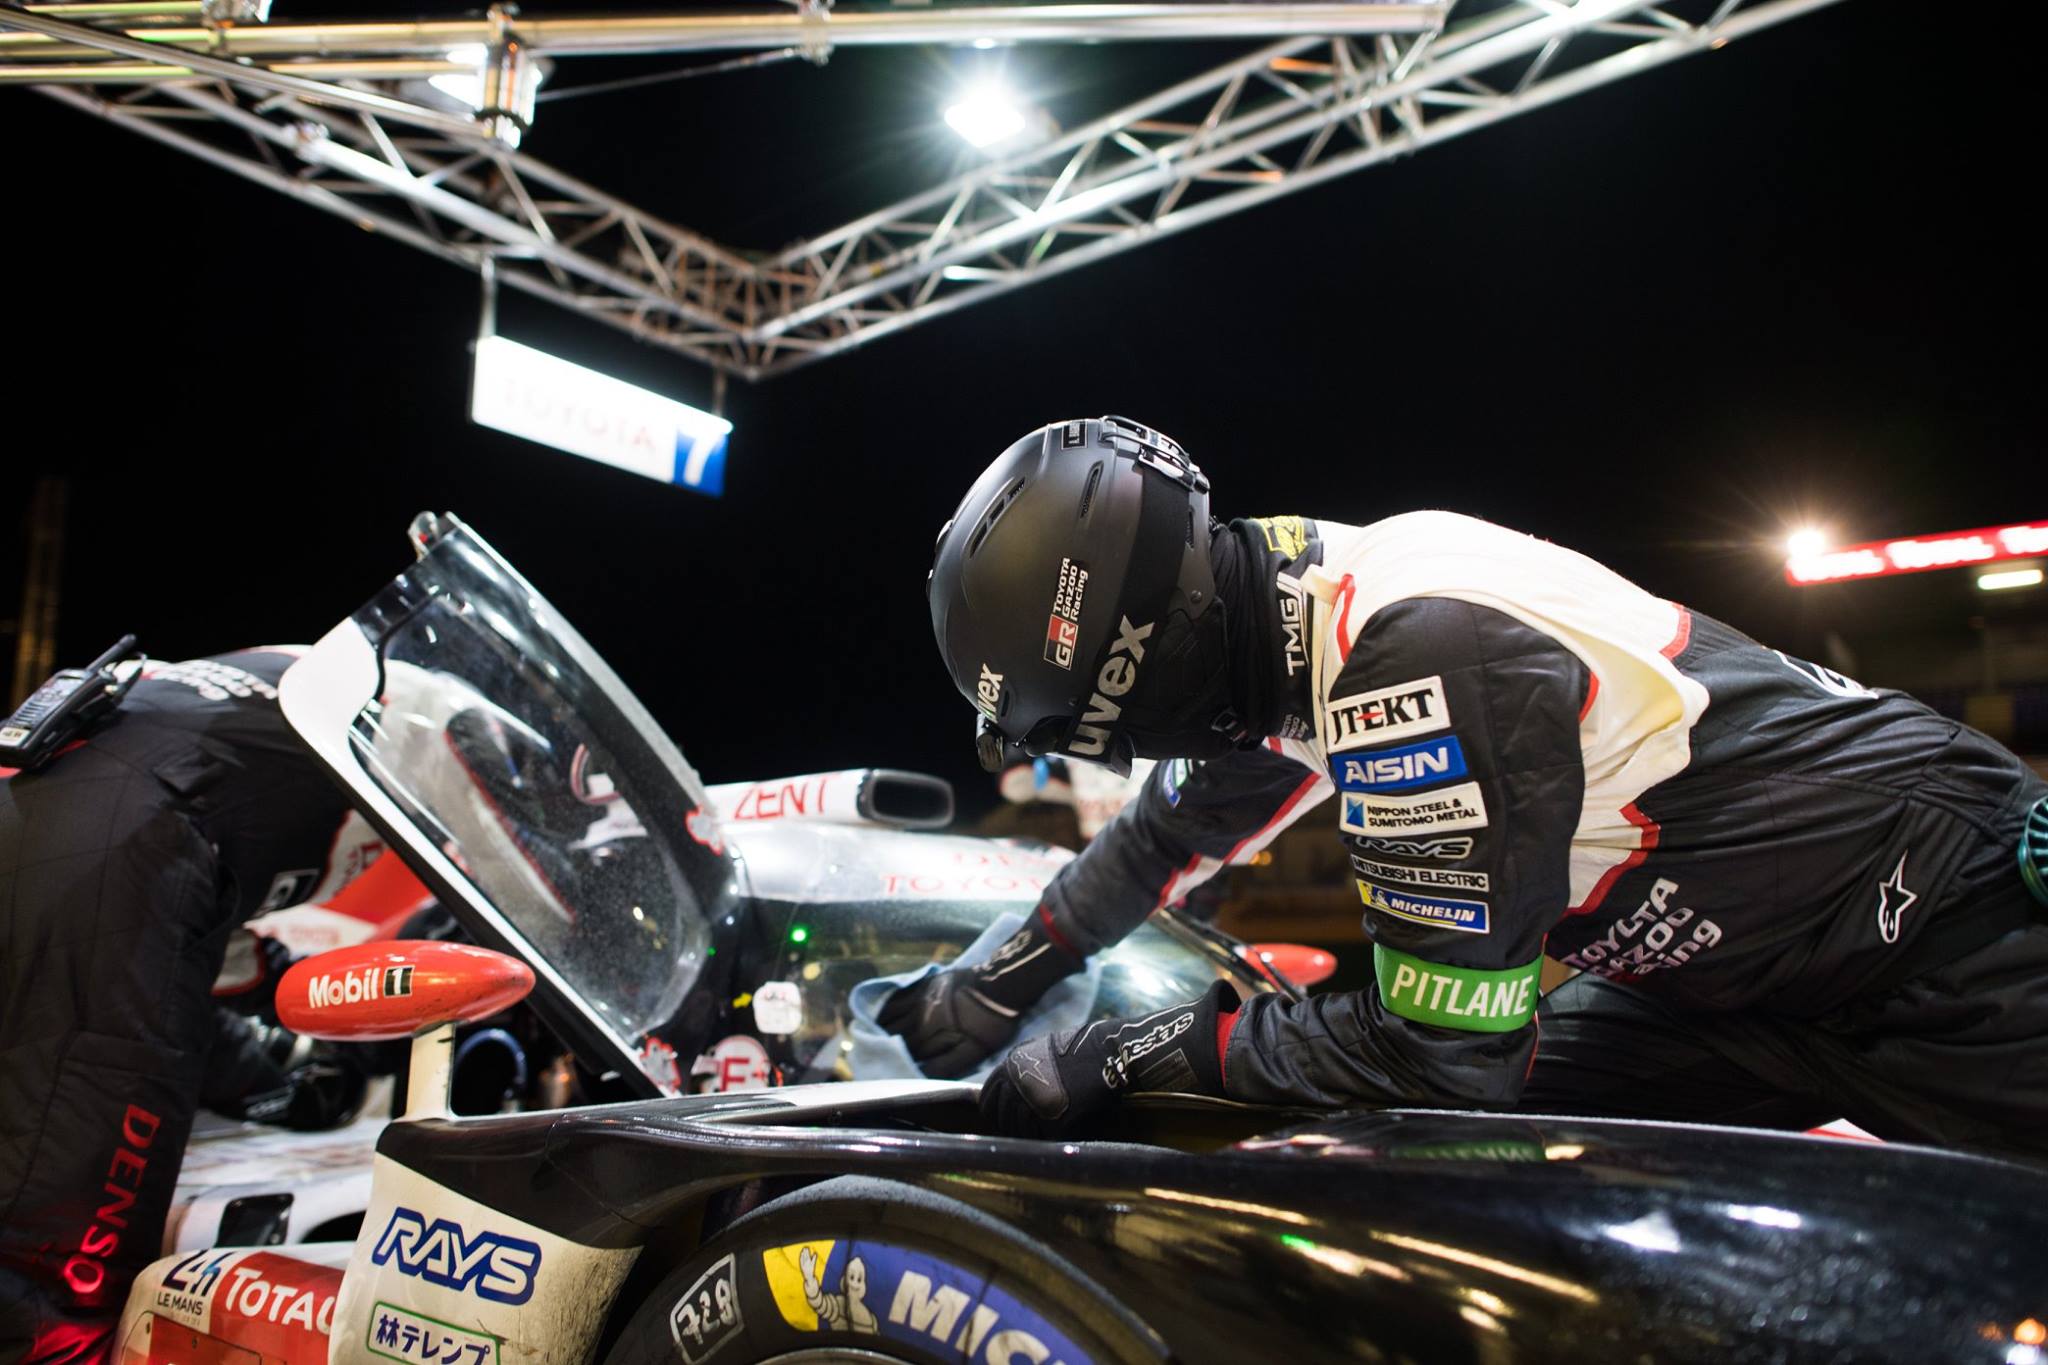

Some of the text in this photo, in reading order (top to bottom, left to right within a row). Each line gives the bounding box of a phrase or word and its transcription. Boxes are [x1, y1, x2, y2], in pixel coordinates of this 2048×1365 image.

[680, 426, 727, 487] 7
[1053, 557, 1071, 614] TOYOTA
[1062, 565, 1079, 618] GAZOO
[1070, 570, 1088, 622] Racing
[1055, 622, 1075, 667] GR
[1281, 598, 1306, 676] TMG
[1068, 614, 1154, 756] uvex
[1331, 689, 1434, 744] JTEKT
[1345, 747, 1448, 784] AISIN
[733, 775, 838, 822] ZENT
[1367, 798, 1462, 817] NIPPON STEEL &
[1368, 808, 1479, 828] SUMITOMO METAL
[1352, 857, 1486, 888] MITSUBISHI ELECTRIC
[1356, 836, 1474, 859] RAYS
[1391, 898, 1476, 922] MICHELIN
[308, 967, 412, 1008] Mobil 1
[1390, 963, 1534, 1018] PITLANE
[64, 1104, 160, 1293] DENSO
[371, 1206, 542, 1306] RAYS
[157, 1292, 204, 1316] LE MANS
[888, 1269, 1066, 1365] MIC
